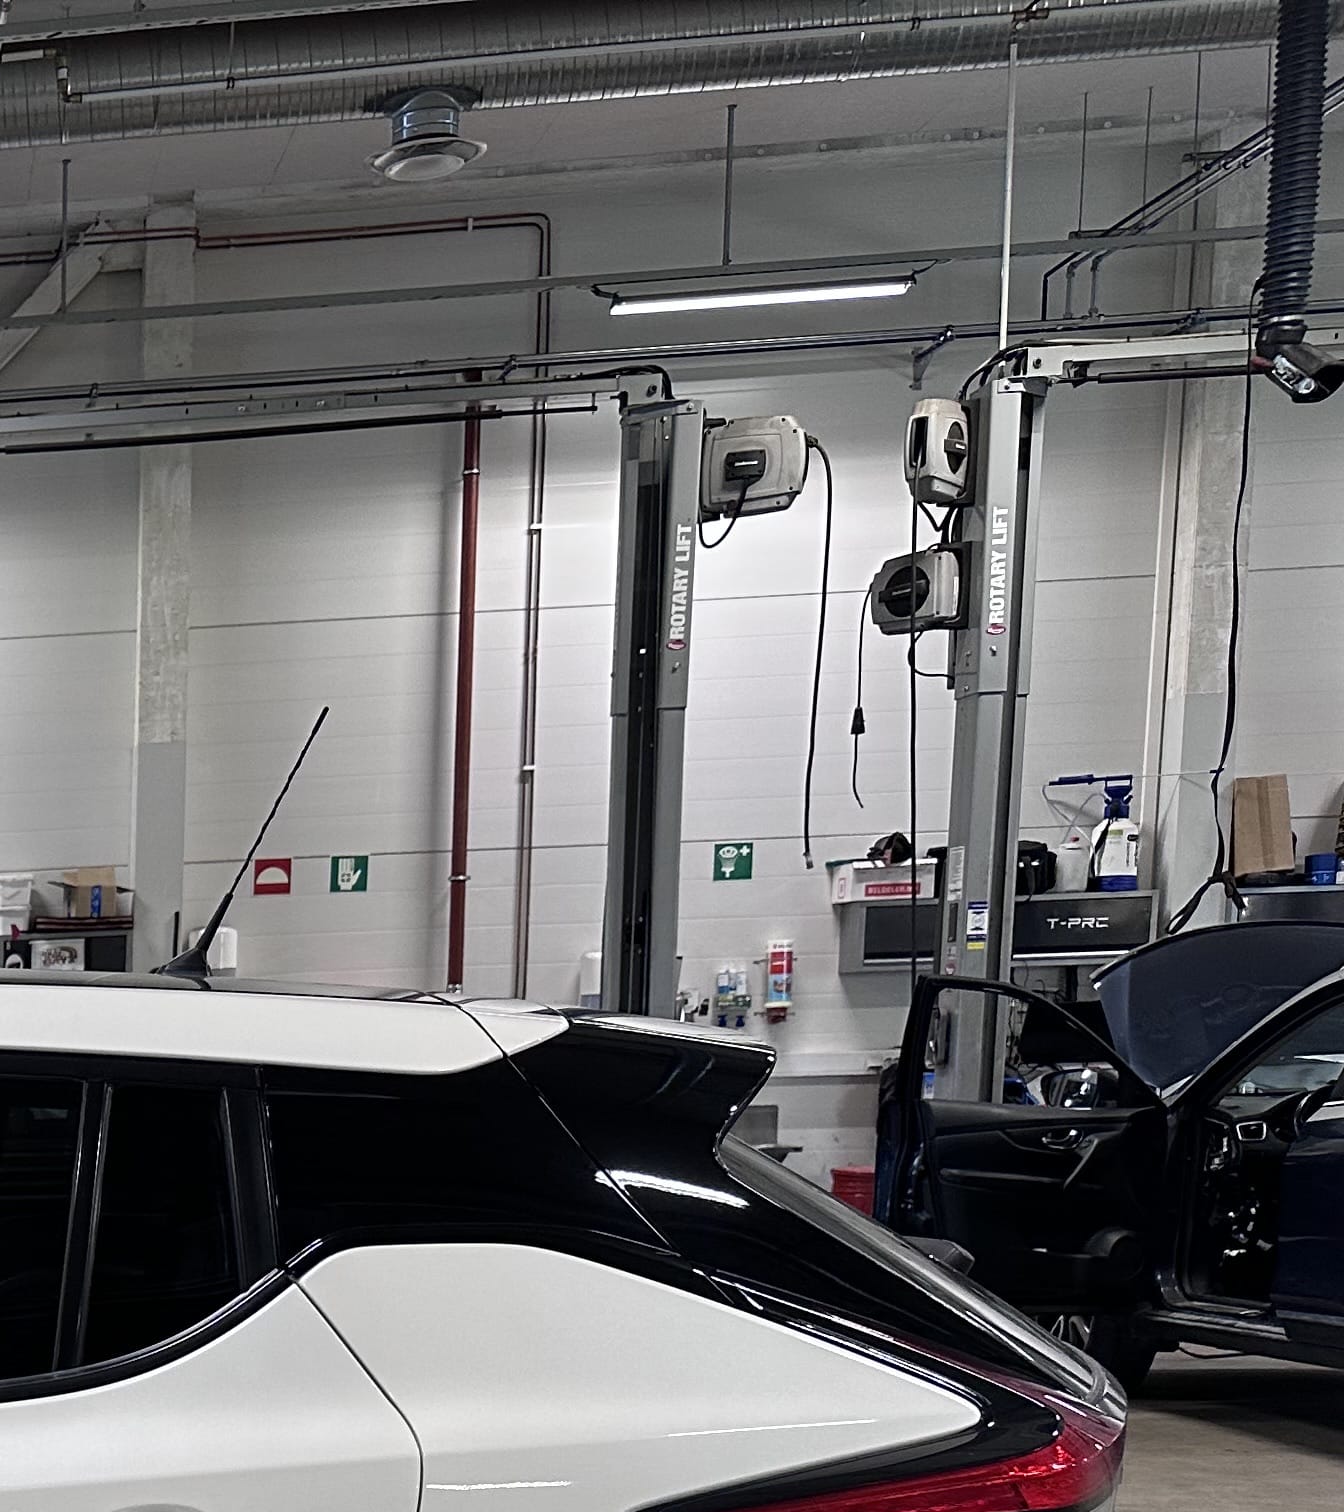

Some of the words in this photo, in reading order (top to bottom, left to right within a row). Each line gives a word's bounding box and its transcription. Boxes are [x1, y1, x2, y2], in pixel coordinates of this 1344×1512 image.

[675, 523, 692, 562] LIFT
[992, 506, 1009, 545] LIFT
[669, 567, 689, 641] ROTARY
[989, 550, 1007, 624] ROTARY
